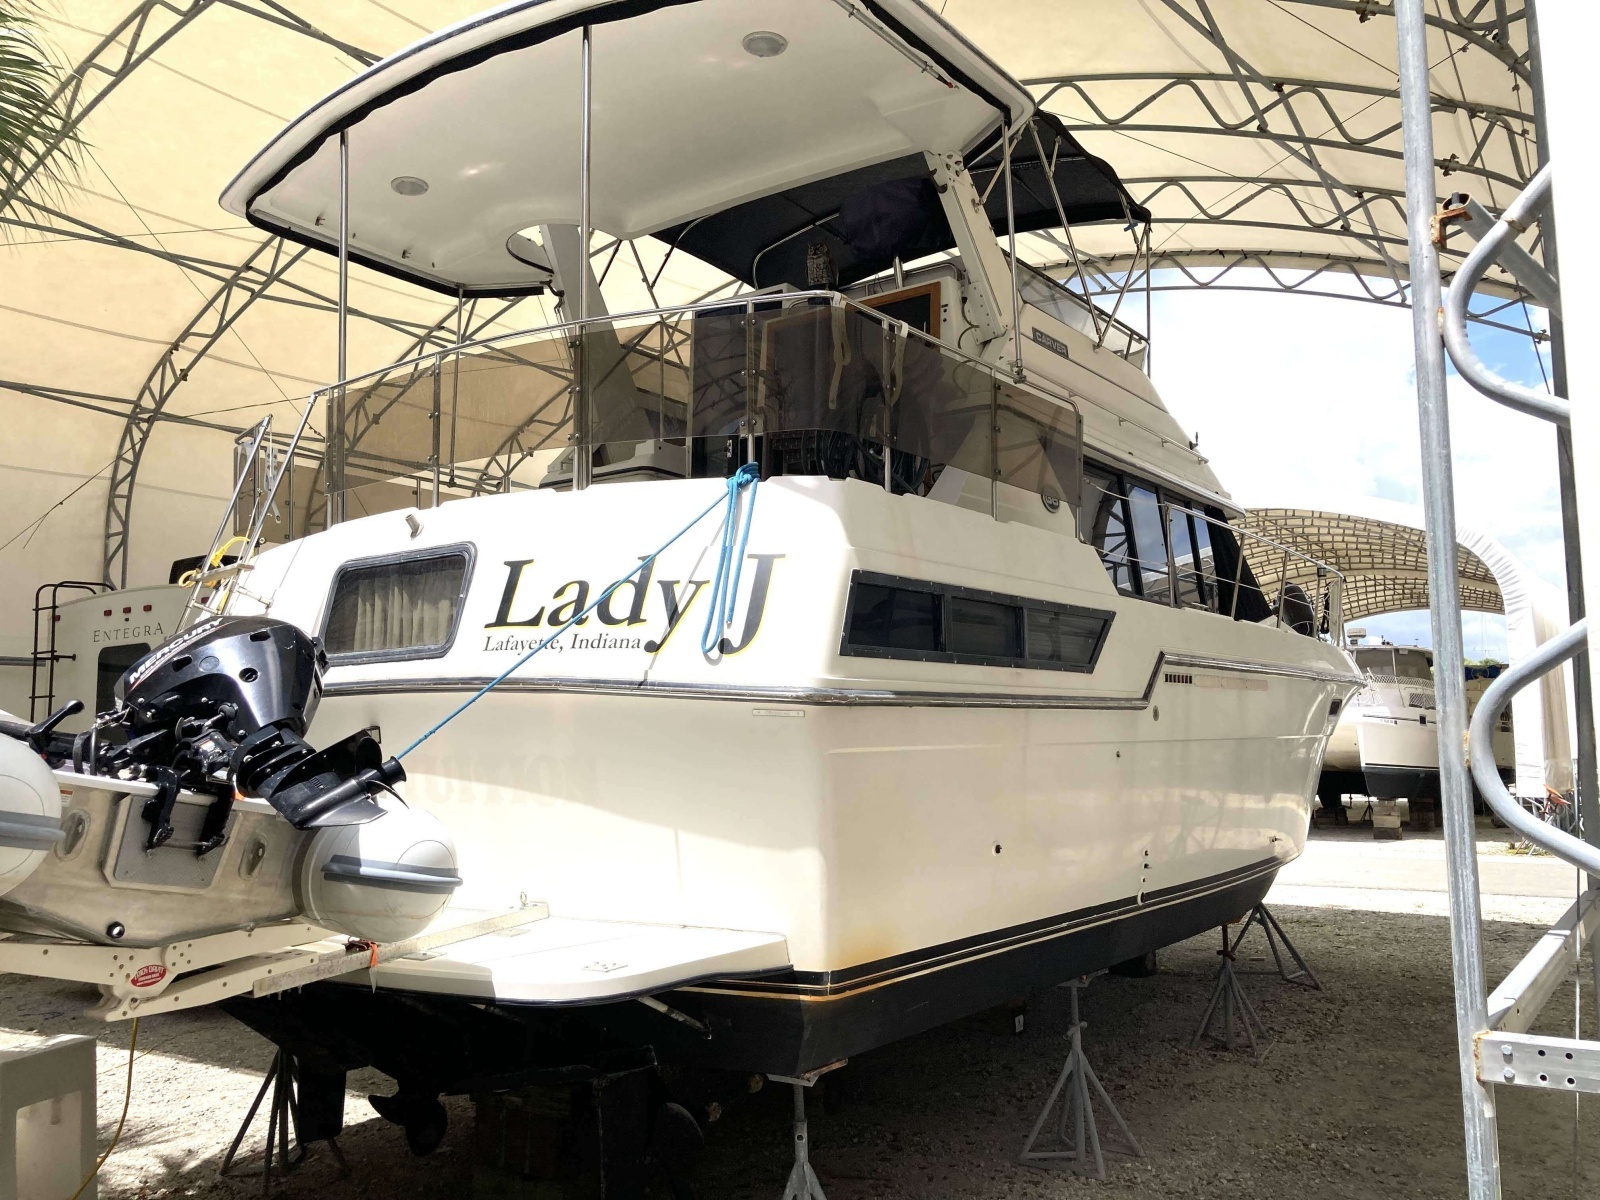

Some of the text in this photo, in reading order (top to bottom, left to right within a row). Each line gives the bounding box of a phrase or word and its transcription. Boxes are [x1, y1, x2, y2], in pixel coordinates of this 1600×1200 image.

[1035, 332, 1067, 355] CARVER
[484, 553, 787, 655] Lady J
[93, 622, 164, 643] ENTEGRA
[570, 633, 641, 650] Indiana
[129, 617, 223, 685] MERCURY
